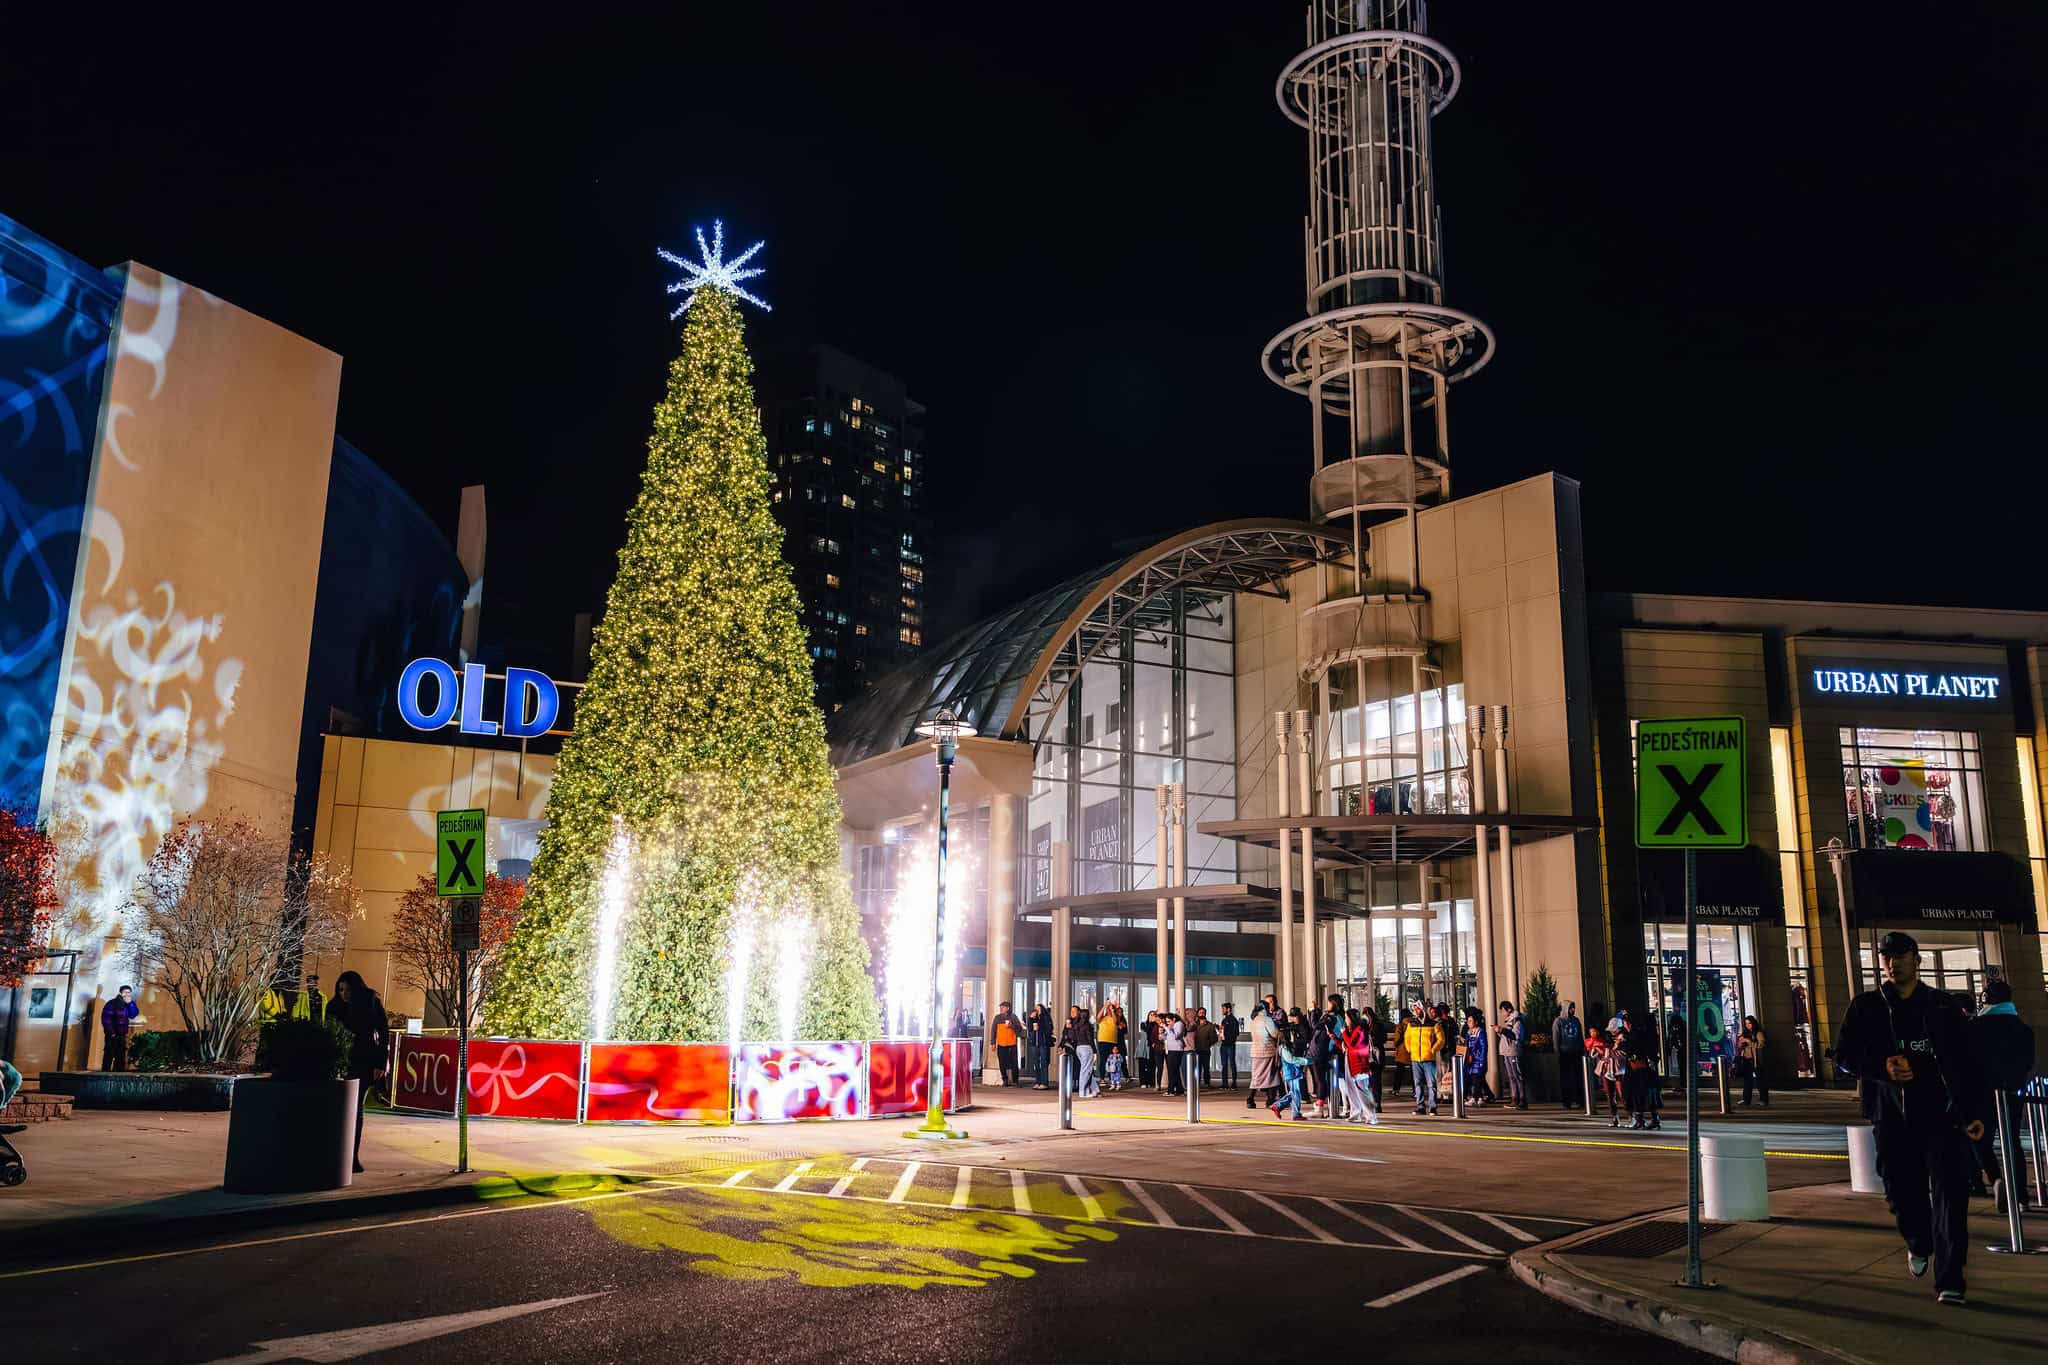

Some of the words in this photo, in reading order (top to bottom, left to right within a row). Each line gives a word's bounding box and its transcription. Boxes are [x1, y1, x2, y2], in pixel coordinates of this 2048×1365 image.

[1814, 671, 1899, 694] URBAN
[1905, 674, 1999, 698] PLANET
[398, 657, 559, 738] OLD
[1641, 730, 1738, 752] PEDESTRIAN
[1654, 763, 1728, 836] X
[439, 818, 482, 833] PEDESTRIAN
[1091, 824, 1117, 846] URBAN
[1089, 841, 1118, 861] PLANET
[445, 839, 477, 887] X
[1696, 904, 1719, 915] BAN
[1722, 905, 1760, 916] PLANET
[1922, 908, 1954, 918] URBAN
[1957, 910, 1994, 919] PLANET
[1111, 957, 1129, 969] STC
[404, 1051, 450, 1096] STC
